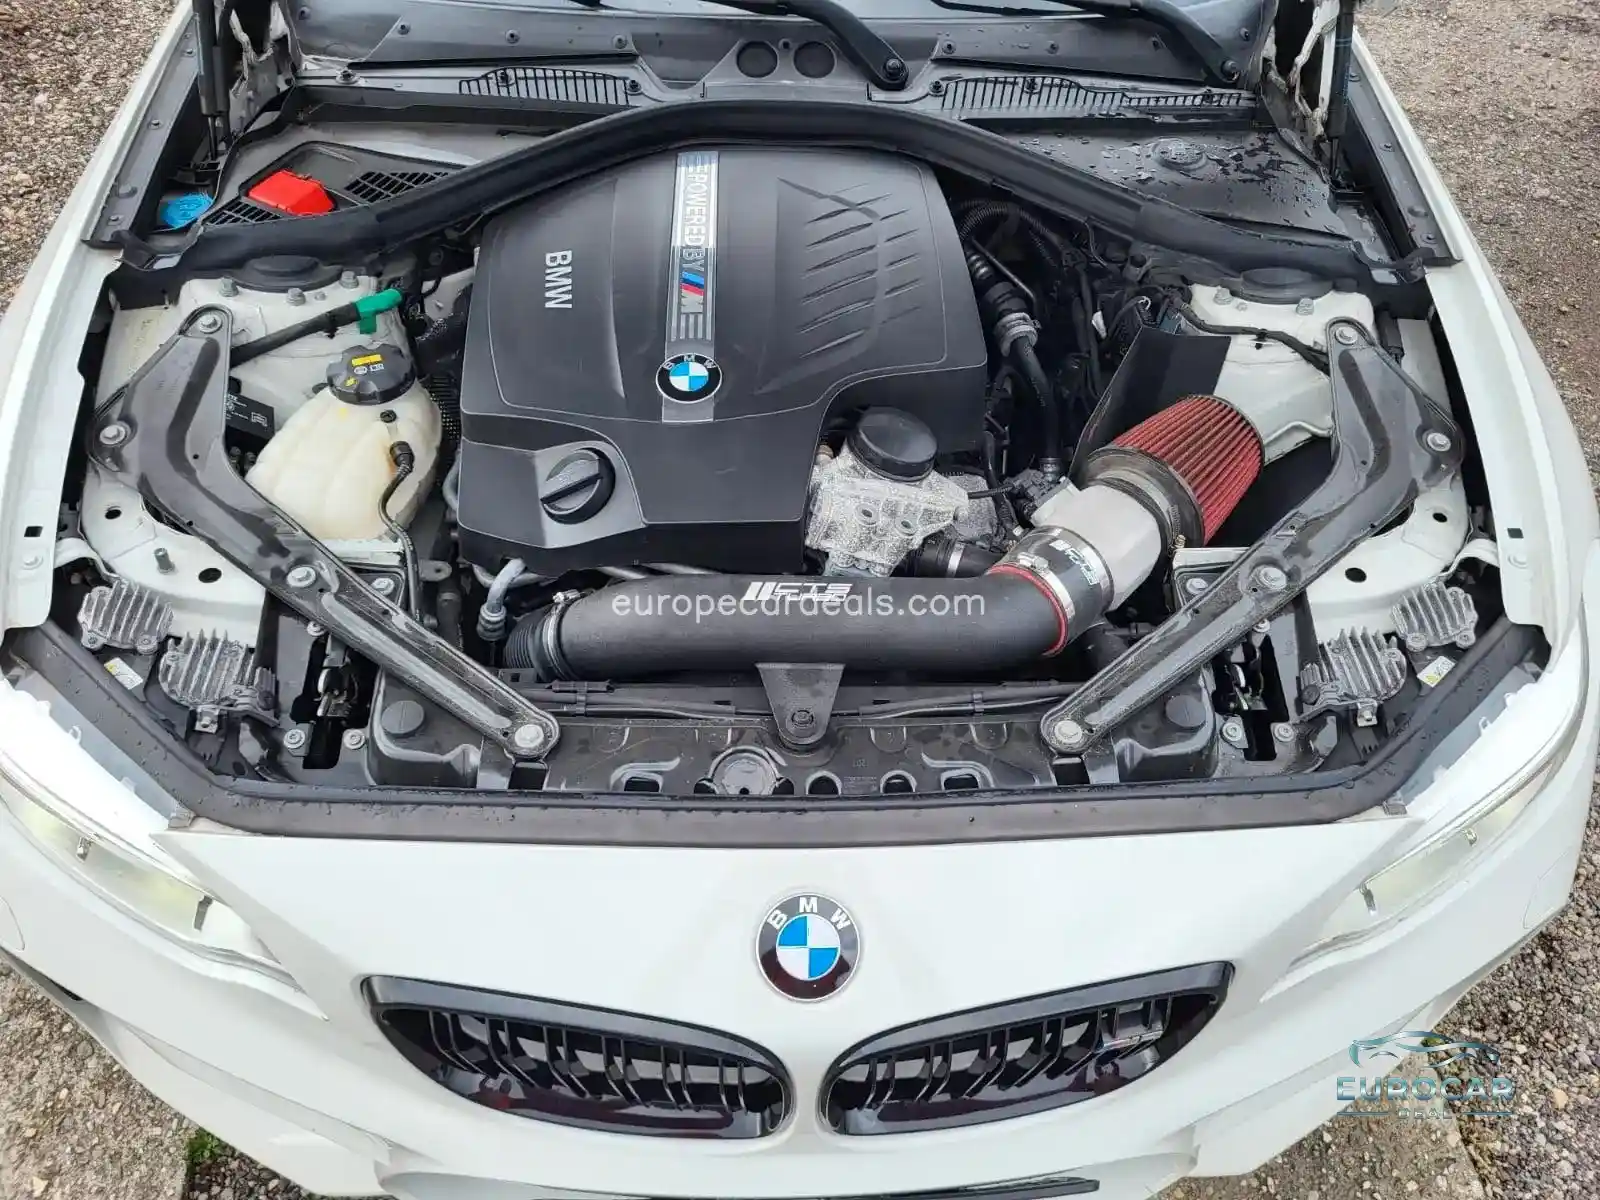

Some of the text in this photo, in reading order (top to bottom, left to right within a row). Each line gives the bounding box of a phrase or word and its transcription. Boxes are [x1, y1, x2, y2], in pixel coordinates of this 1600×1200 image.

[684, 173, 708, 247] POWERED
[682, 248, 706, 272] BY
[544, 250, 573, 309] BMW
[662, 353, 718, 371] BMW
[766, 896, 851, 930] BMW
